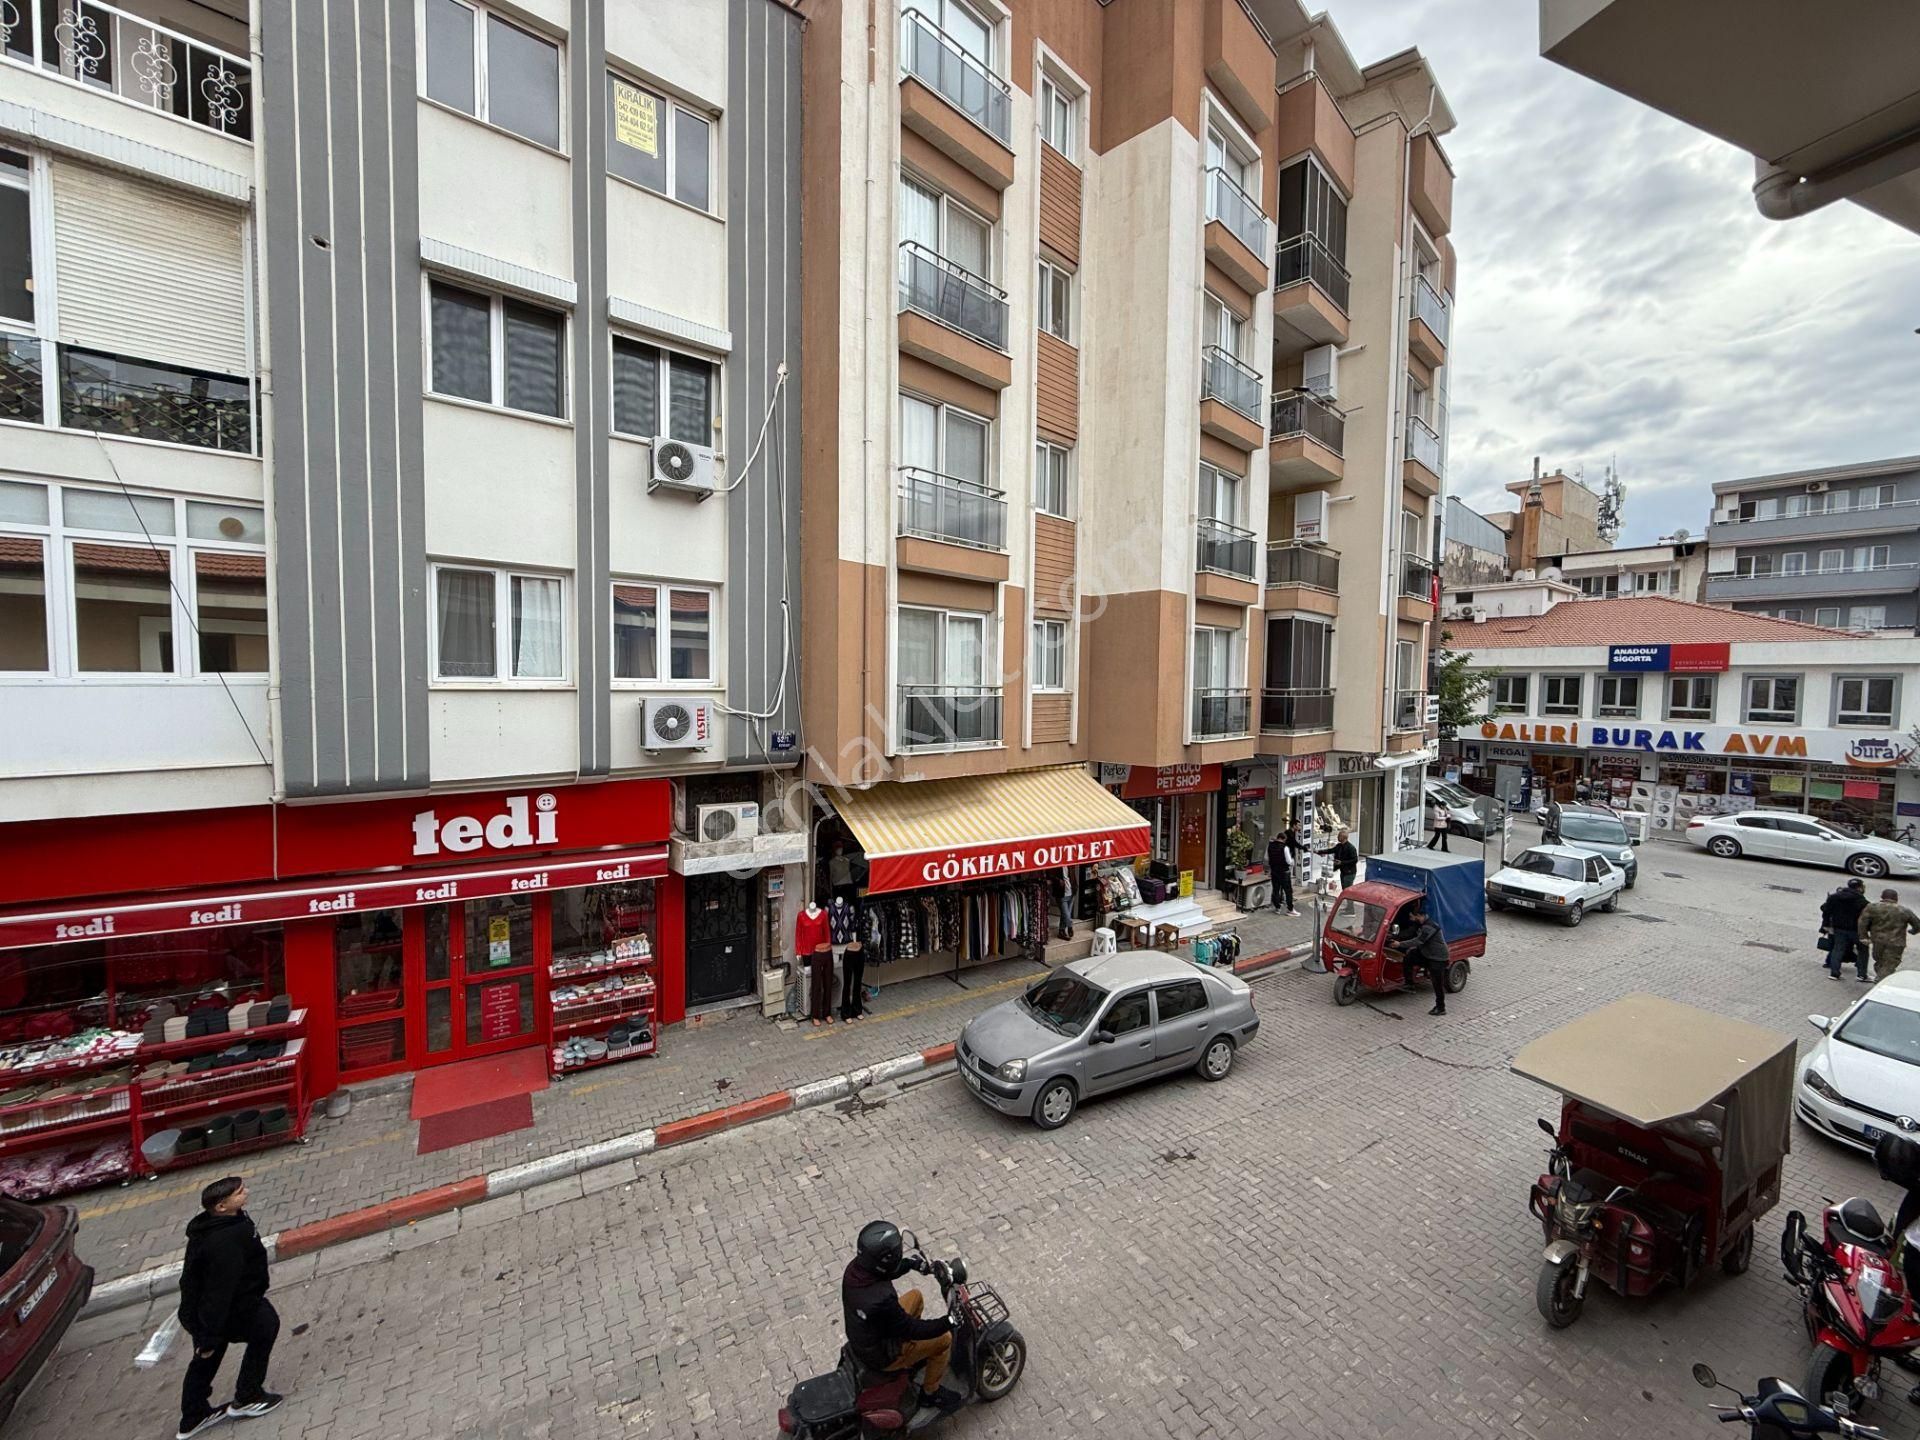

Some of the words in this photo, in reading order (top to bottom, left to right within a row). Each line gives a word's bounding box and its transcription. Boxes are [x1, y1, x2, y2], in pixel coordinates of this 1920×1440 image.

[1613, 654, 1652, 663] SİGORTA
[697, 706, 705, 740] VESTEL
[1481, 721, 1578, 744] GALERİ
[1592, 727, 1706, 752] BURAK
[1723, 733, 1808, 757] AVM
[1493, 748, 1527, 757] REGAL
[1602, 756, 1639, 766] BOSCH
[1667, 754, 1722, 765] SAMSUNG
[1851, 739, 1910, 764] burak
[1103, 765, 1127, 777] Reflex
[1156, 776, 1175, 789] PET
[1176, 774, 1201, 787] SHOP
[412, 793, 559, 856] tedi
[922, 850, 1025, 882] GÖKHAN
[1033, 839, 1115, 867] OUTLET
[511, 872, 549, 891] tedi
[596, 864, 630, 881] tedi
[416, 882, 458, 901] tedi
[309, 892, 356, 913] tedi
[190, 904, 242, 925] tedi
[56, 915, 115, 939] tedi
